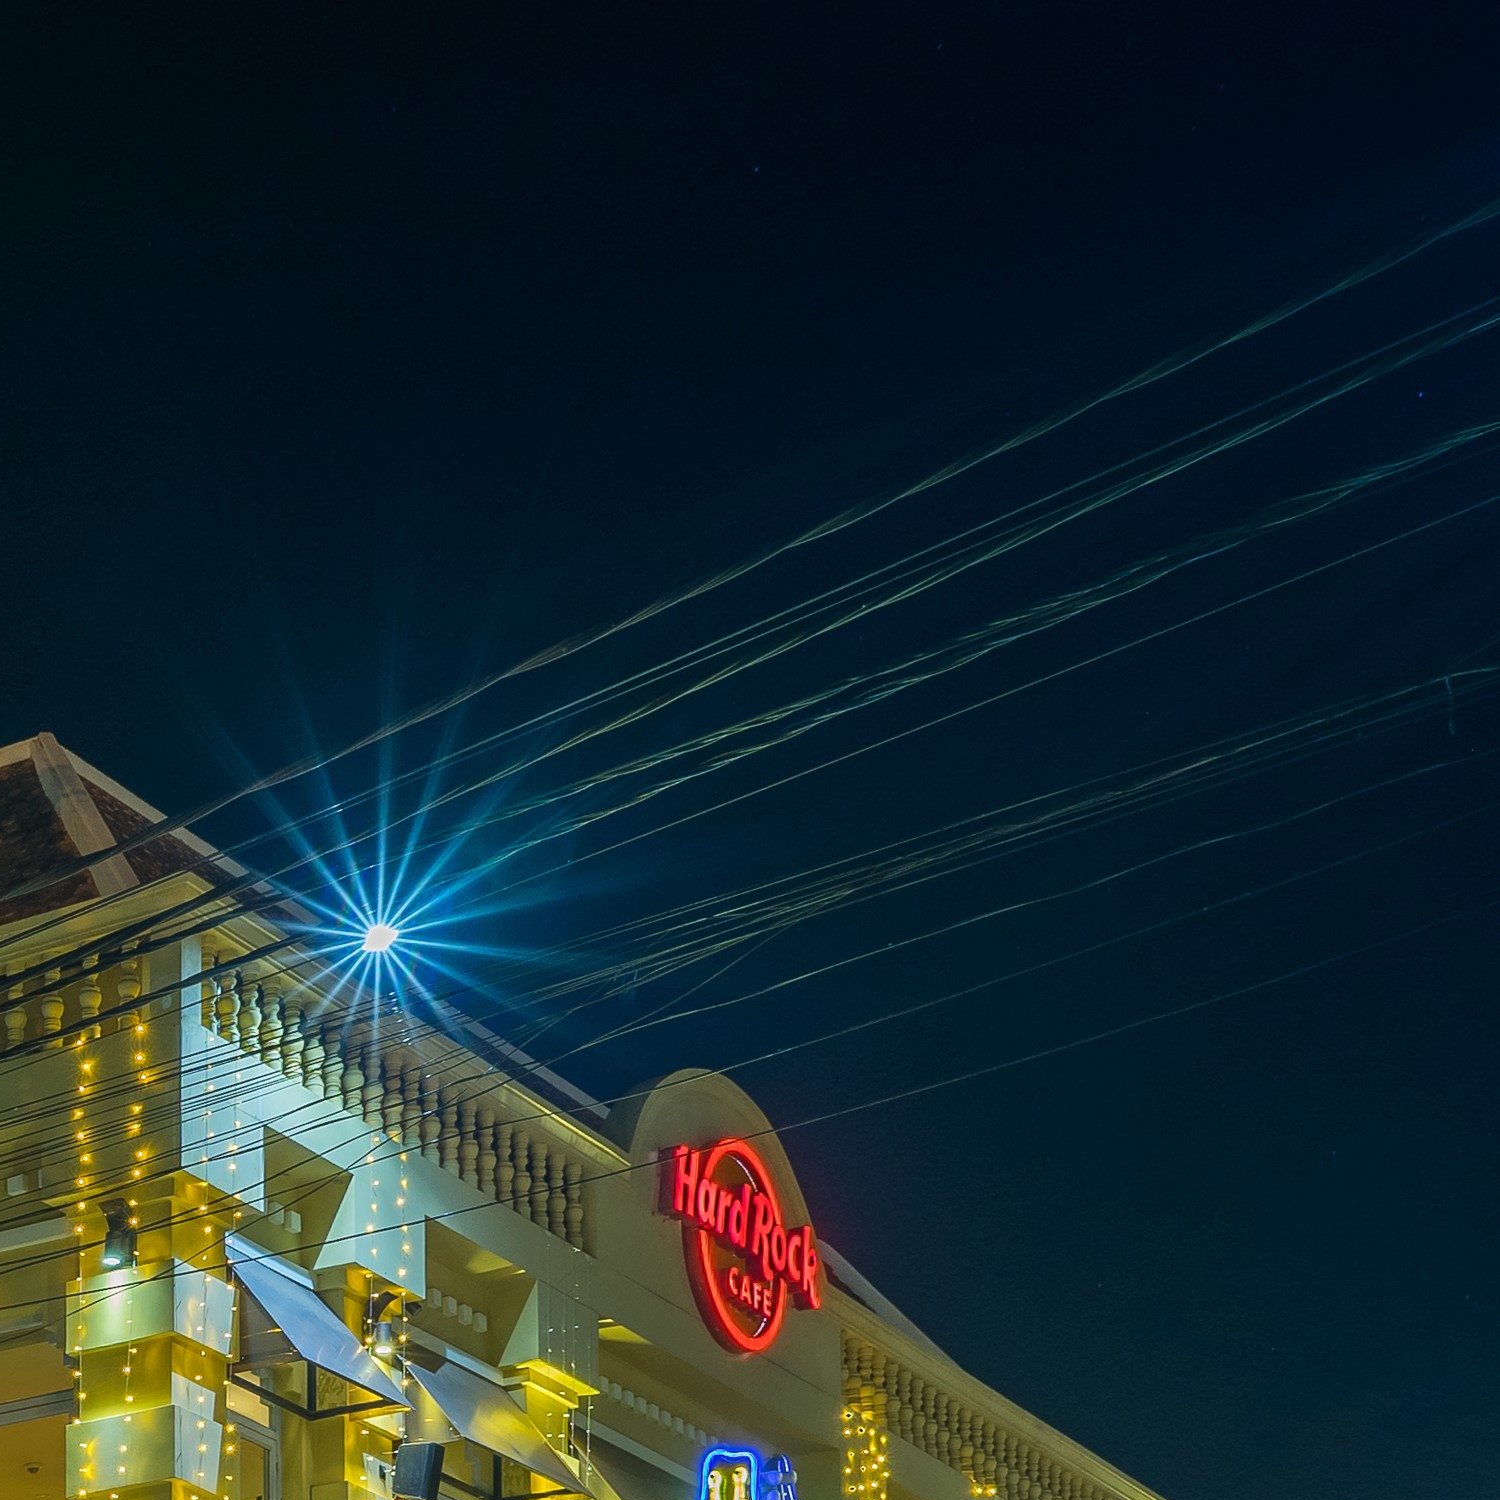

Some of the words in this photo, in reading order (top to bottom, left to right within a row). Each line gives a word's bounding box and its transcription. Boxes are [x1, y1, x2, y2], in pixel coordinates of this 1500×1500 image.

[673, 1144, 751, 1249] Hard
[752, 1191, 821, 1310] Rock
[728, 1266, 772, 1317] CAFE
